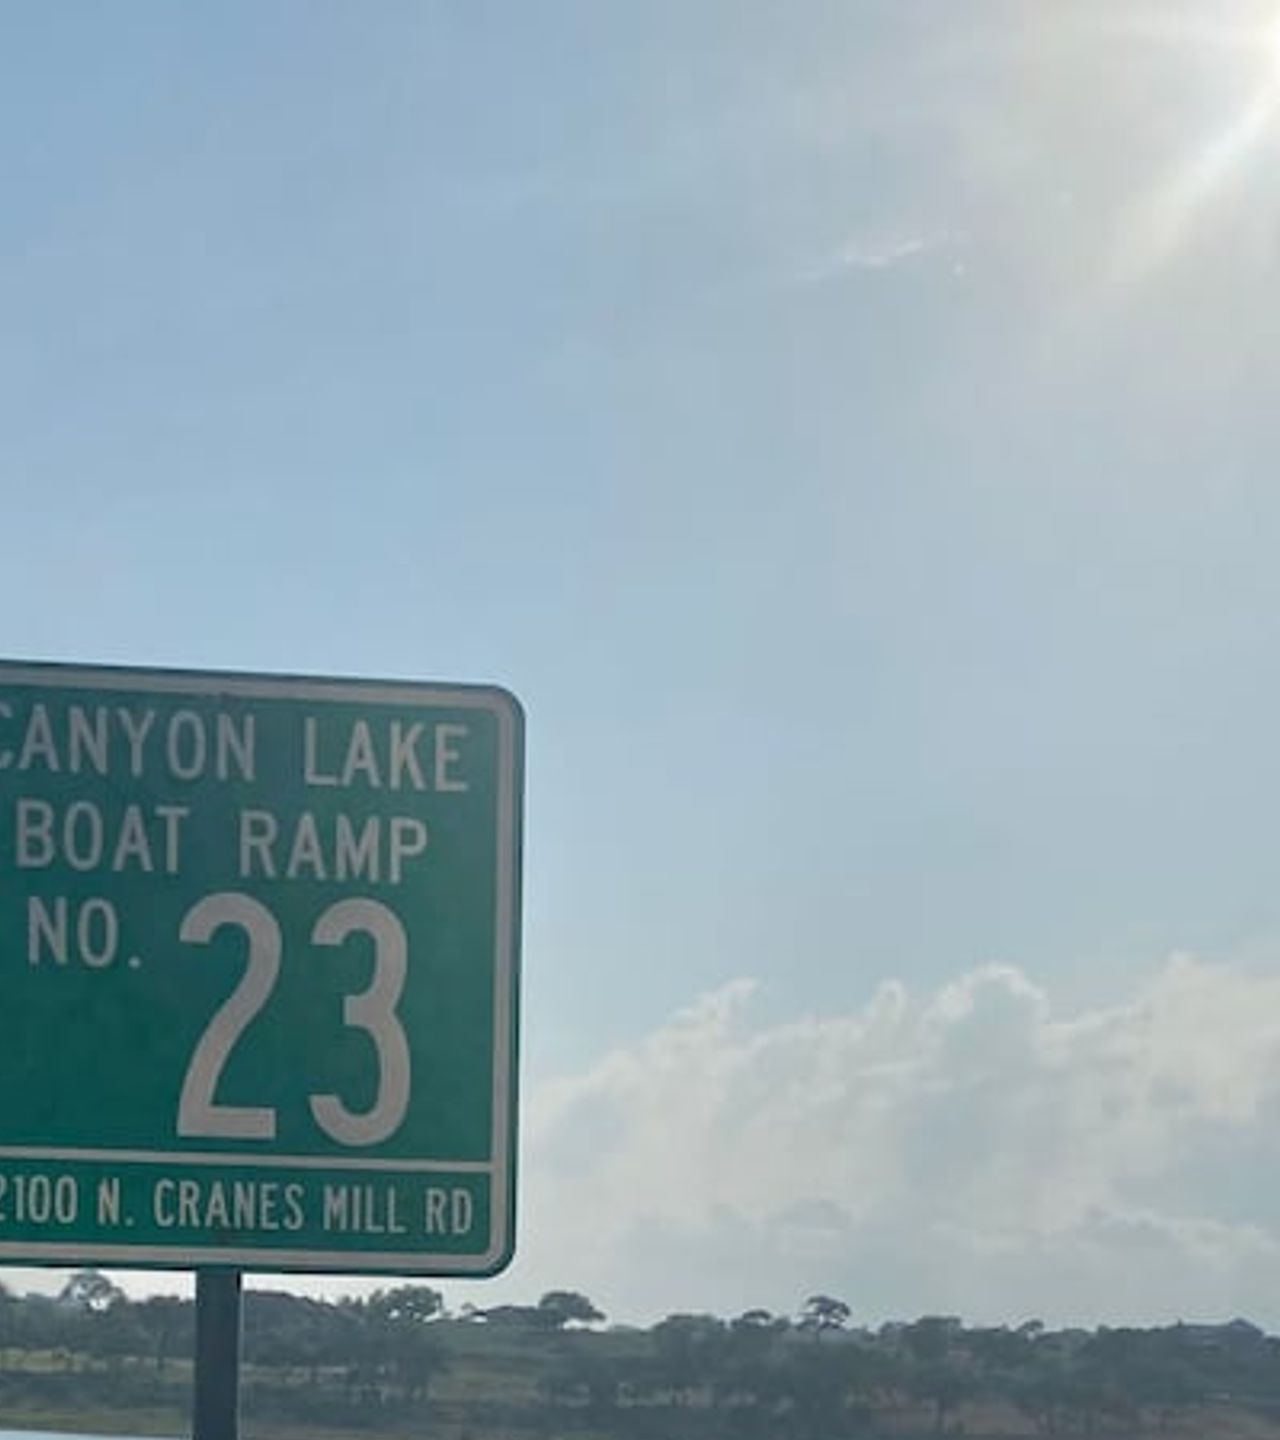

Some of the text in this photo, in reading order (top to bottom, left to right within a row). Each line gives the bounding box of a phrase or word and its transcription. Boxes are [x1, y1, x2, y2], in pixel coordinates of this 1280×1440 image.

[305, 716, 470, 793] LAKE
[16, 800, 429, 884] BOAT RAMP
[27, 891, 413, 1148] NO. 23
[98, 1176, 134, 1228] N.
[154, 1178, 304, 1231] CRANES
[323, 1184, 407, 1234] MILL
[425, 1188, 474, 1235] RD
